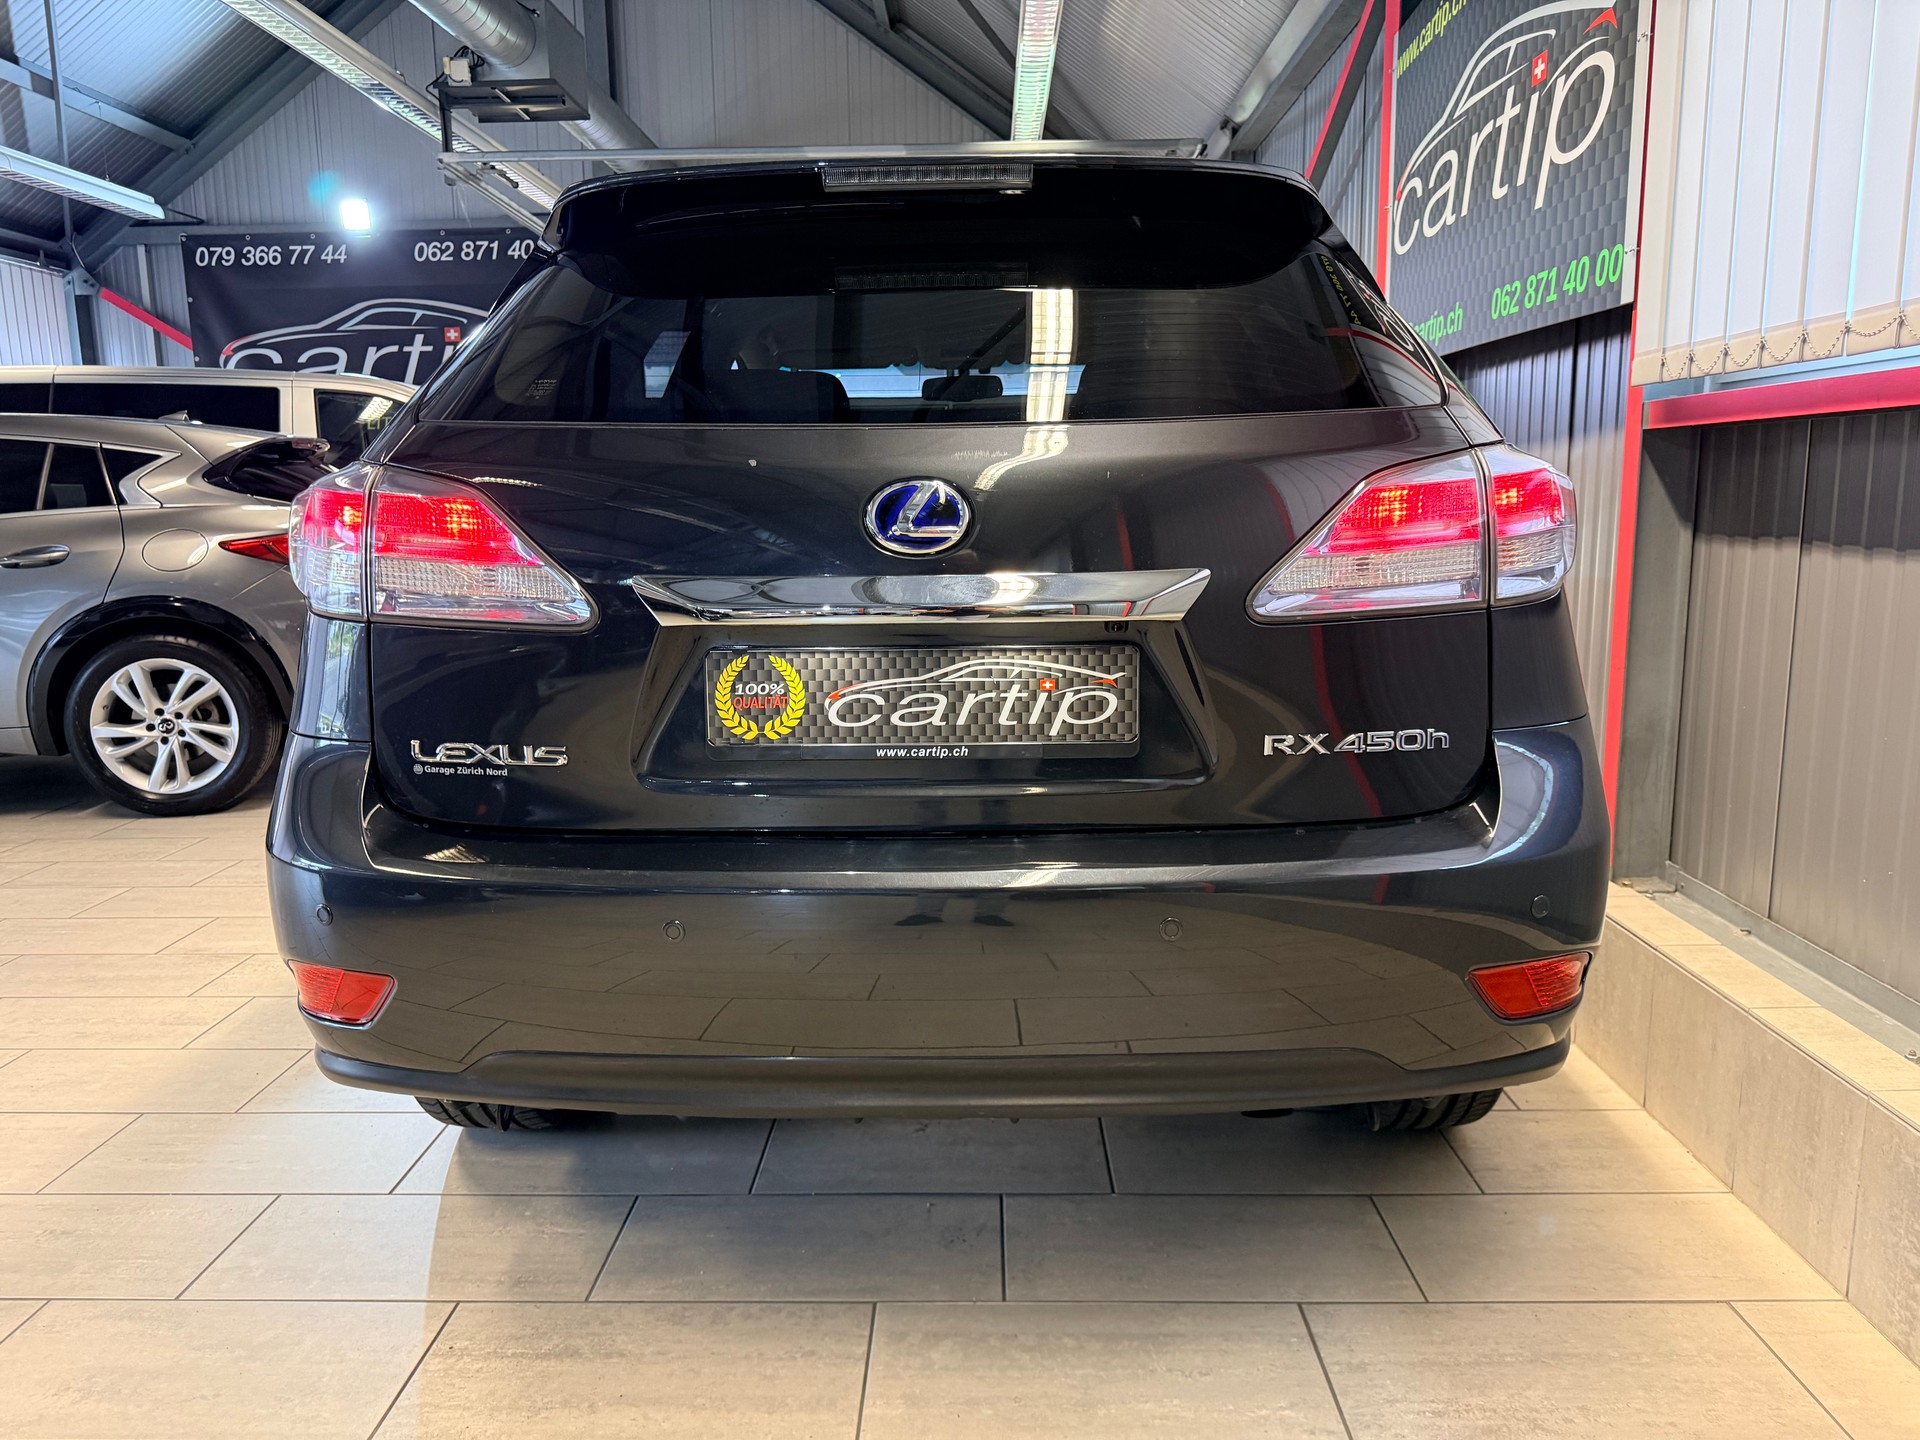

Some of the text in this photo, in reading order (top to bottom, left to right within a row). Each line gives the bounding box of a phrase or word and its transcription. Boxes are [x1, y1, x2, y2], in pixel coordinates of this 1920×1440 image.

[1393, 50, 1616, 255] cartip
[195, 243, 347, 266] 079 366 77 44
[414, 239, 535, 262] 062 871 40
[1491, 243, 1624, 320] 062 871 40 00
[1409, 301, 1463, 347] artip.ch
[225, 328, 456, 385] cart
[734, 683, 785, 695] 100%
[733, 694, 788, 712] QUALITÄT
[827, 679, 1119, 736] cartip
[410, 739, 568, 766] LEXUS
[876, 745, 969, 759] www.cartip.ch
[1263, 728, 1450, 756] RX 450h
[424, 765, 508, 776] Garage Zürich Nord
